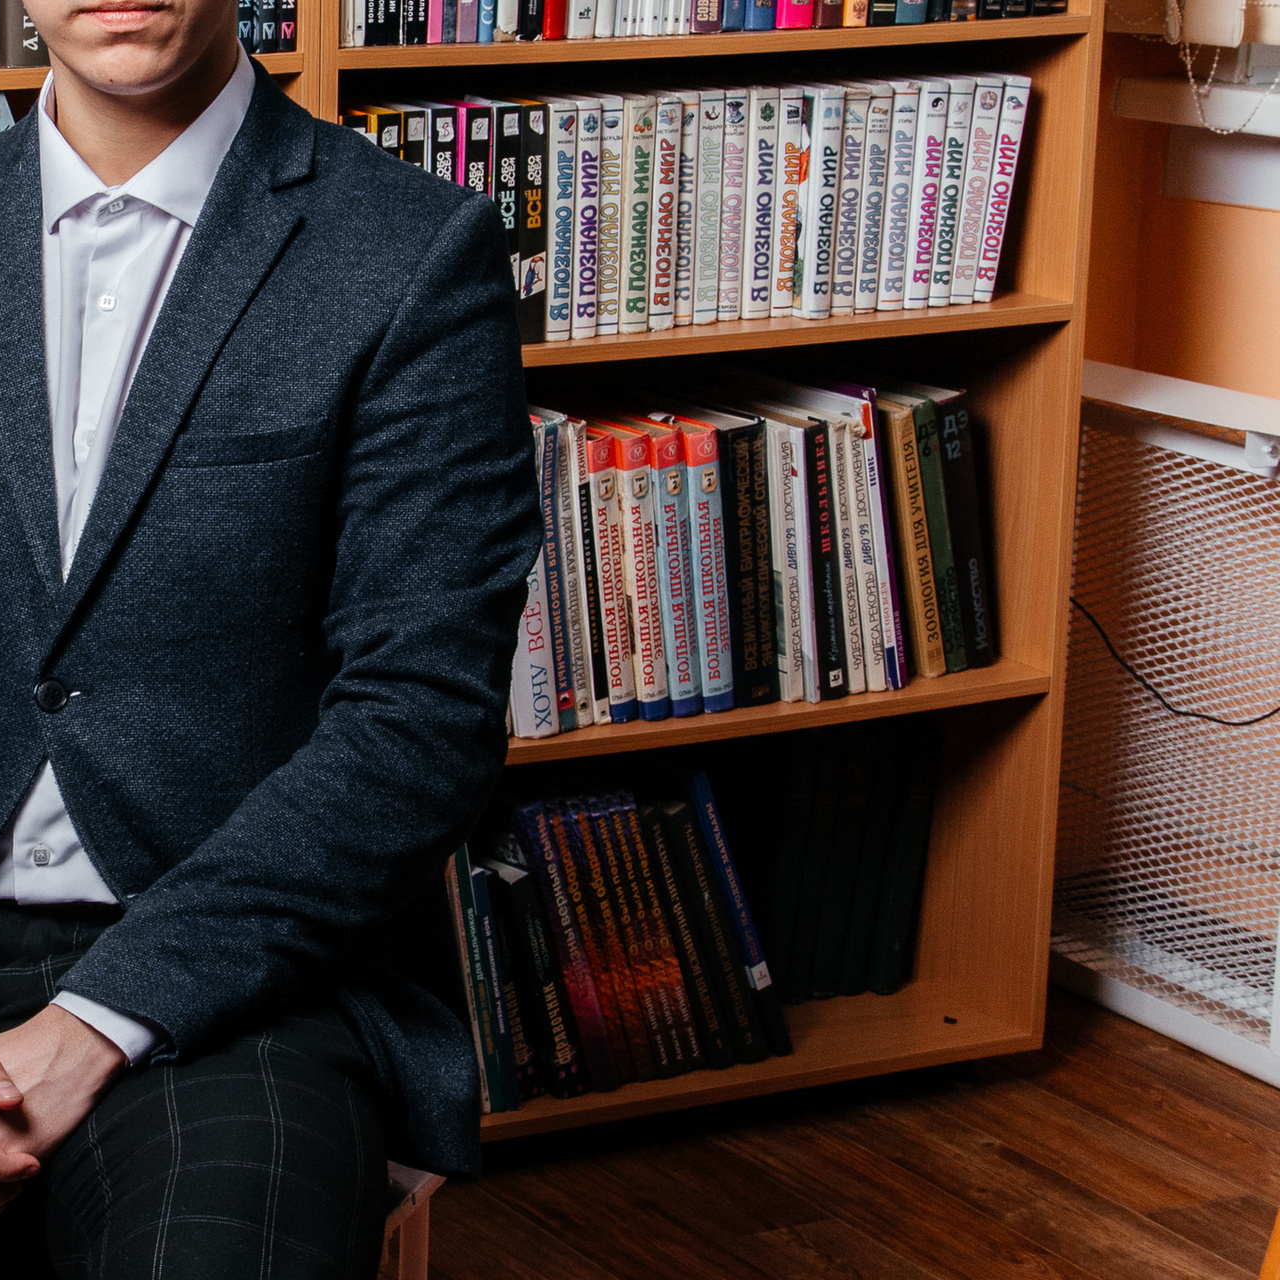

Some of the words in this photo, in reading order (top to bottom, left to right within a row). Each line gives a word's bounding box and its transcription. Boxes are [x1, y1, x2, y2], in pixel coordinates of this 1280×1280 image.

[556, 150, 573, 200] МИР
[554, 206, 573, 299] ПОЗНАЮ
[549, 305, 569, 321] Я
[902, 441, 923, 516] УЧИТЕЛЯ
[597, 506, 614, 605] ШКОЛЬНАЯ
[914, 521, 928, 550] ДЛЯ
[920, 556, 940, 642] ЗООЛОГИЯ
[605, 607, 622, 690] БОЛЬШАЯ
